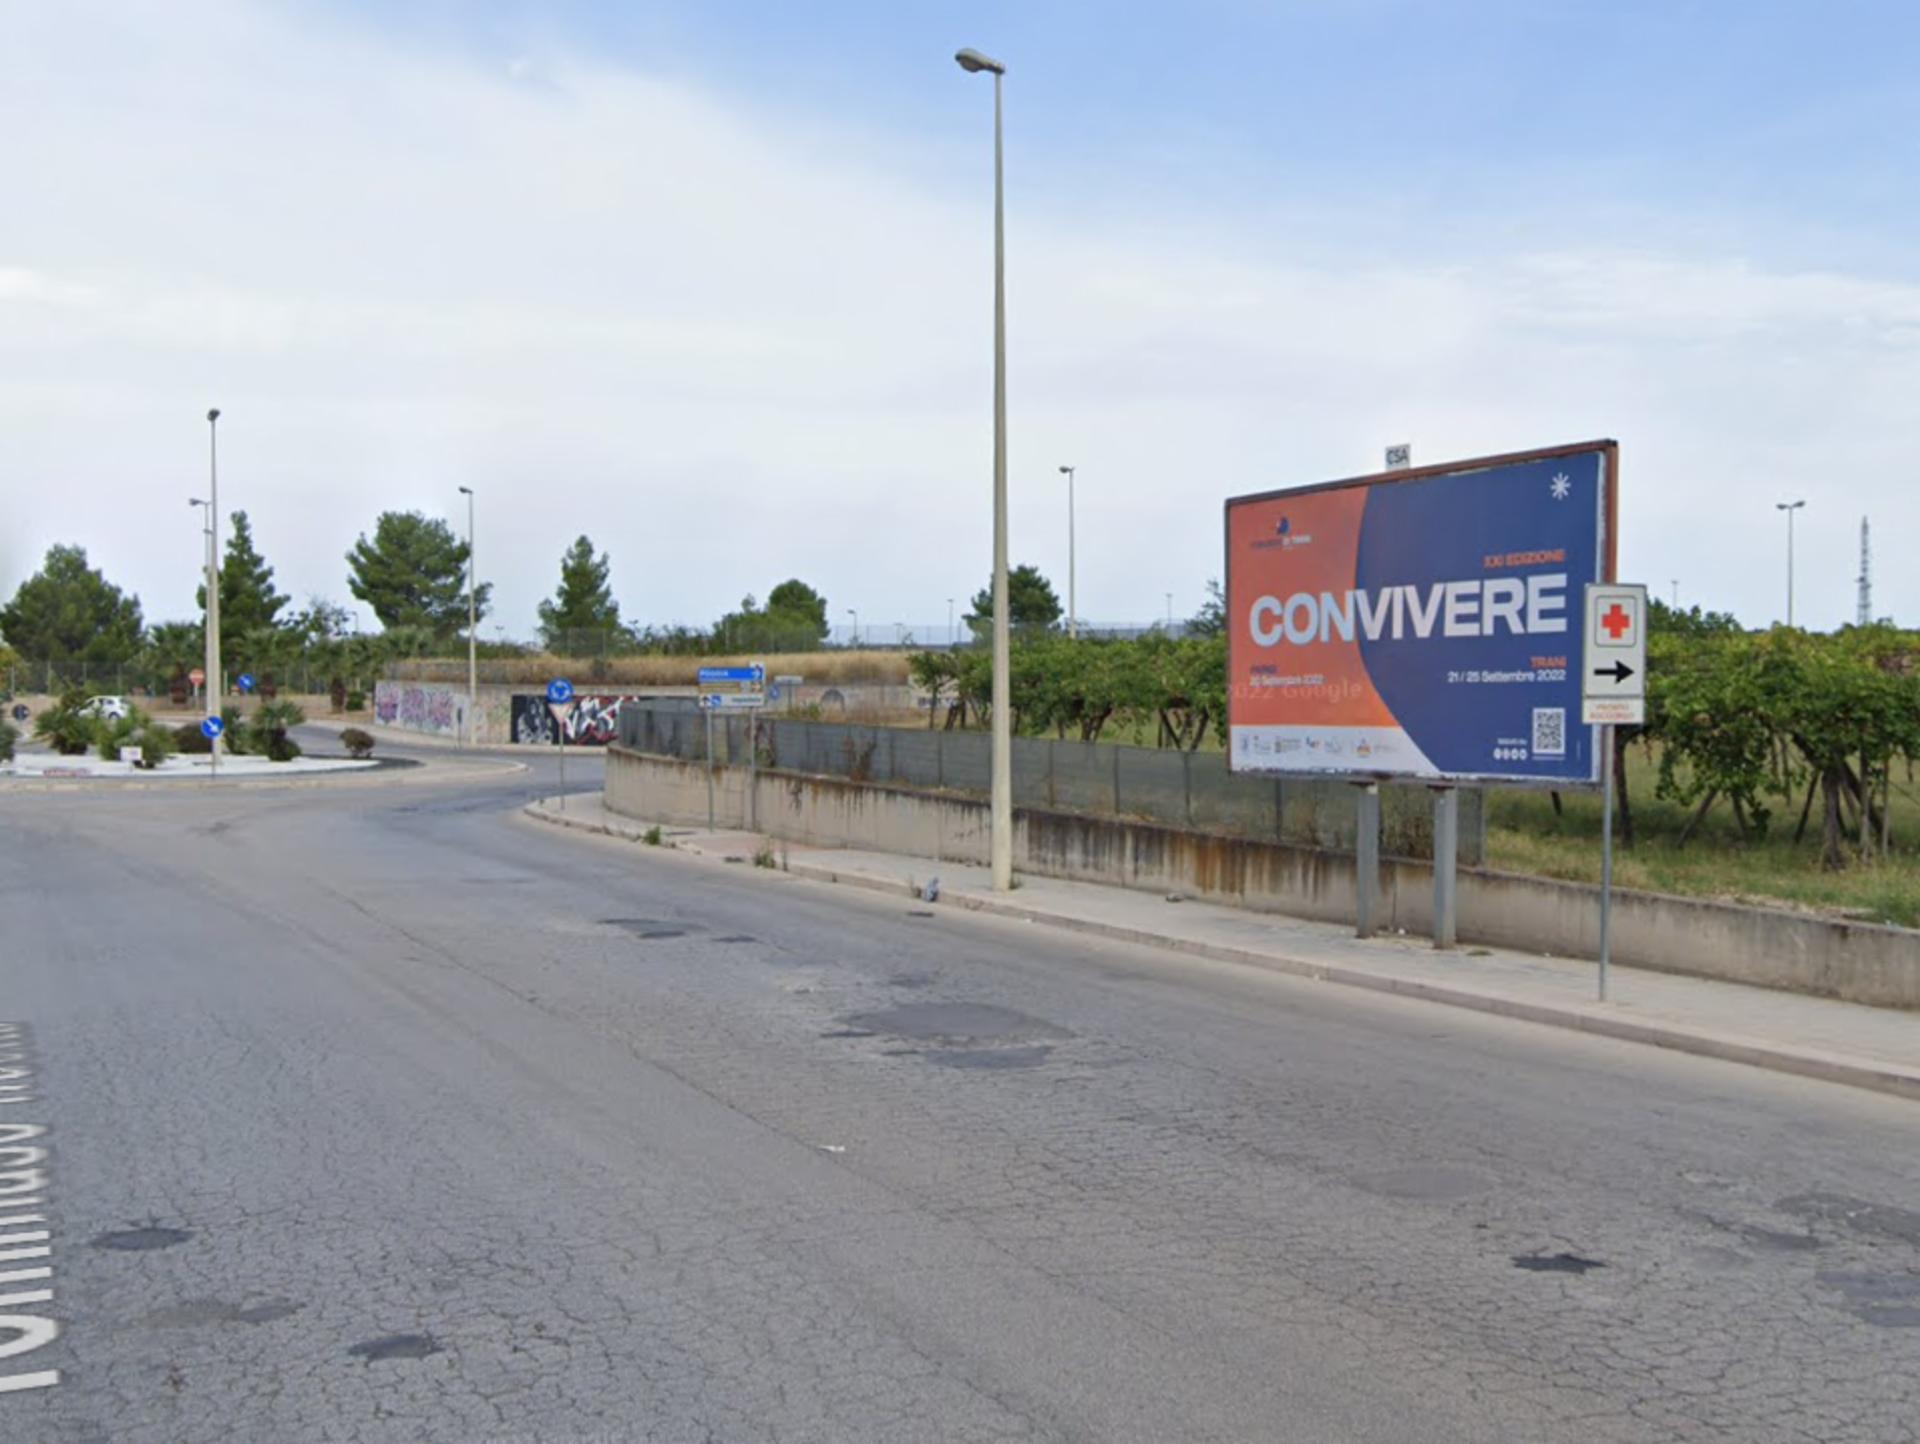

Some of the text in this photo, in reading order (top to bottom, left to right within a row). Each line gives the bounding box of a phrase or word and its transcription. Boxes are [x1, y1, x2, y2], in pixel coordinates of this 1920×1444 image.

[1386, 447, 1409, 465] CSA
[1505, 548, 1566, 566] EDIZIONE
[1249, 573, 1568, 648] CONVIVERE
[1530, 656, 1567, 669] TRANI
[1481, 670, 1535, 683] Settembre
[1536, 669, 1567, 682] 2022
